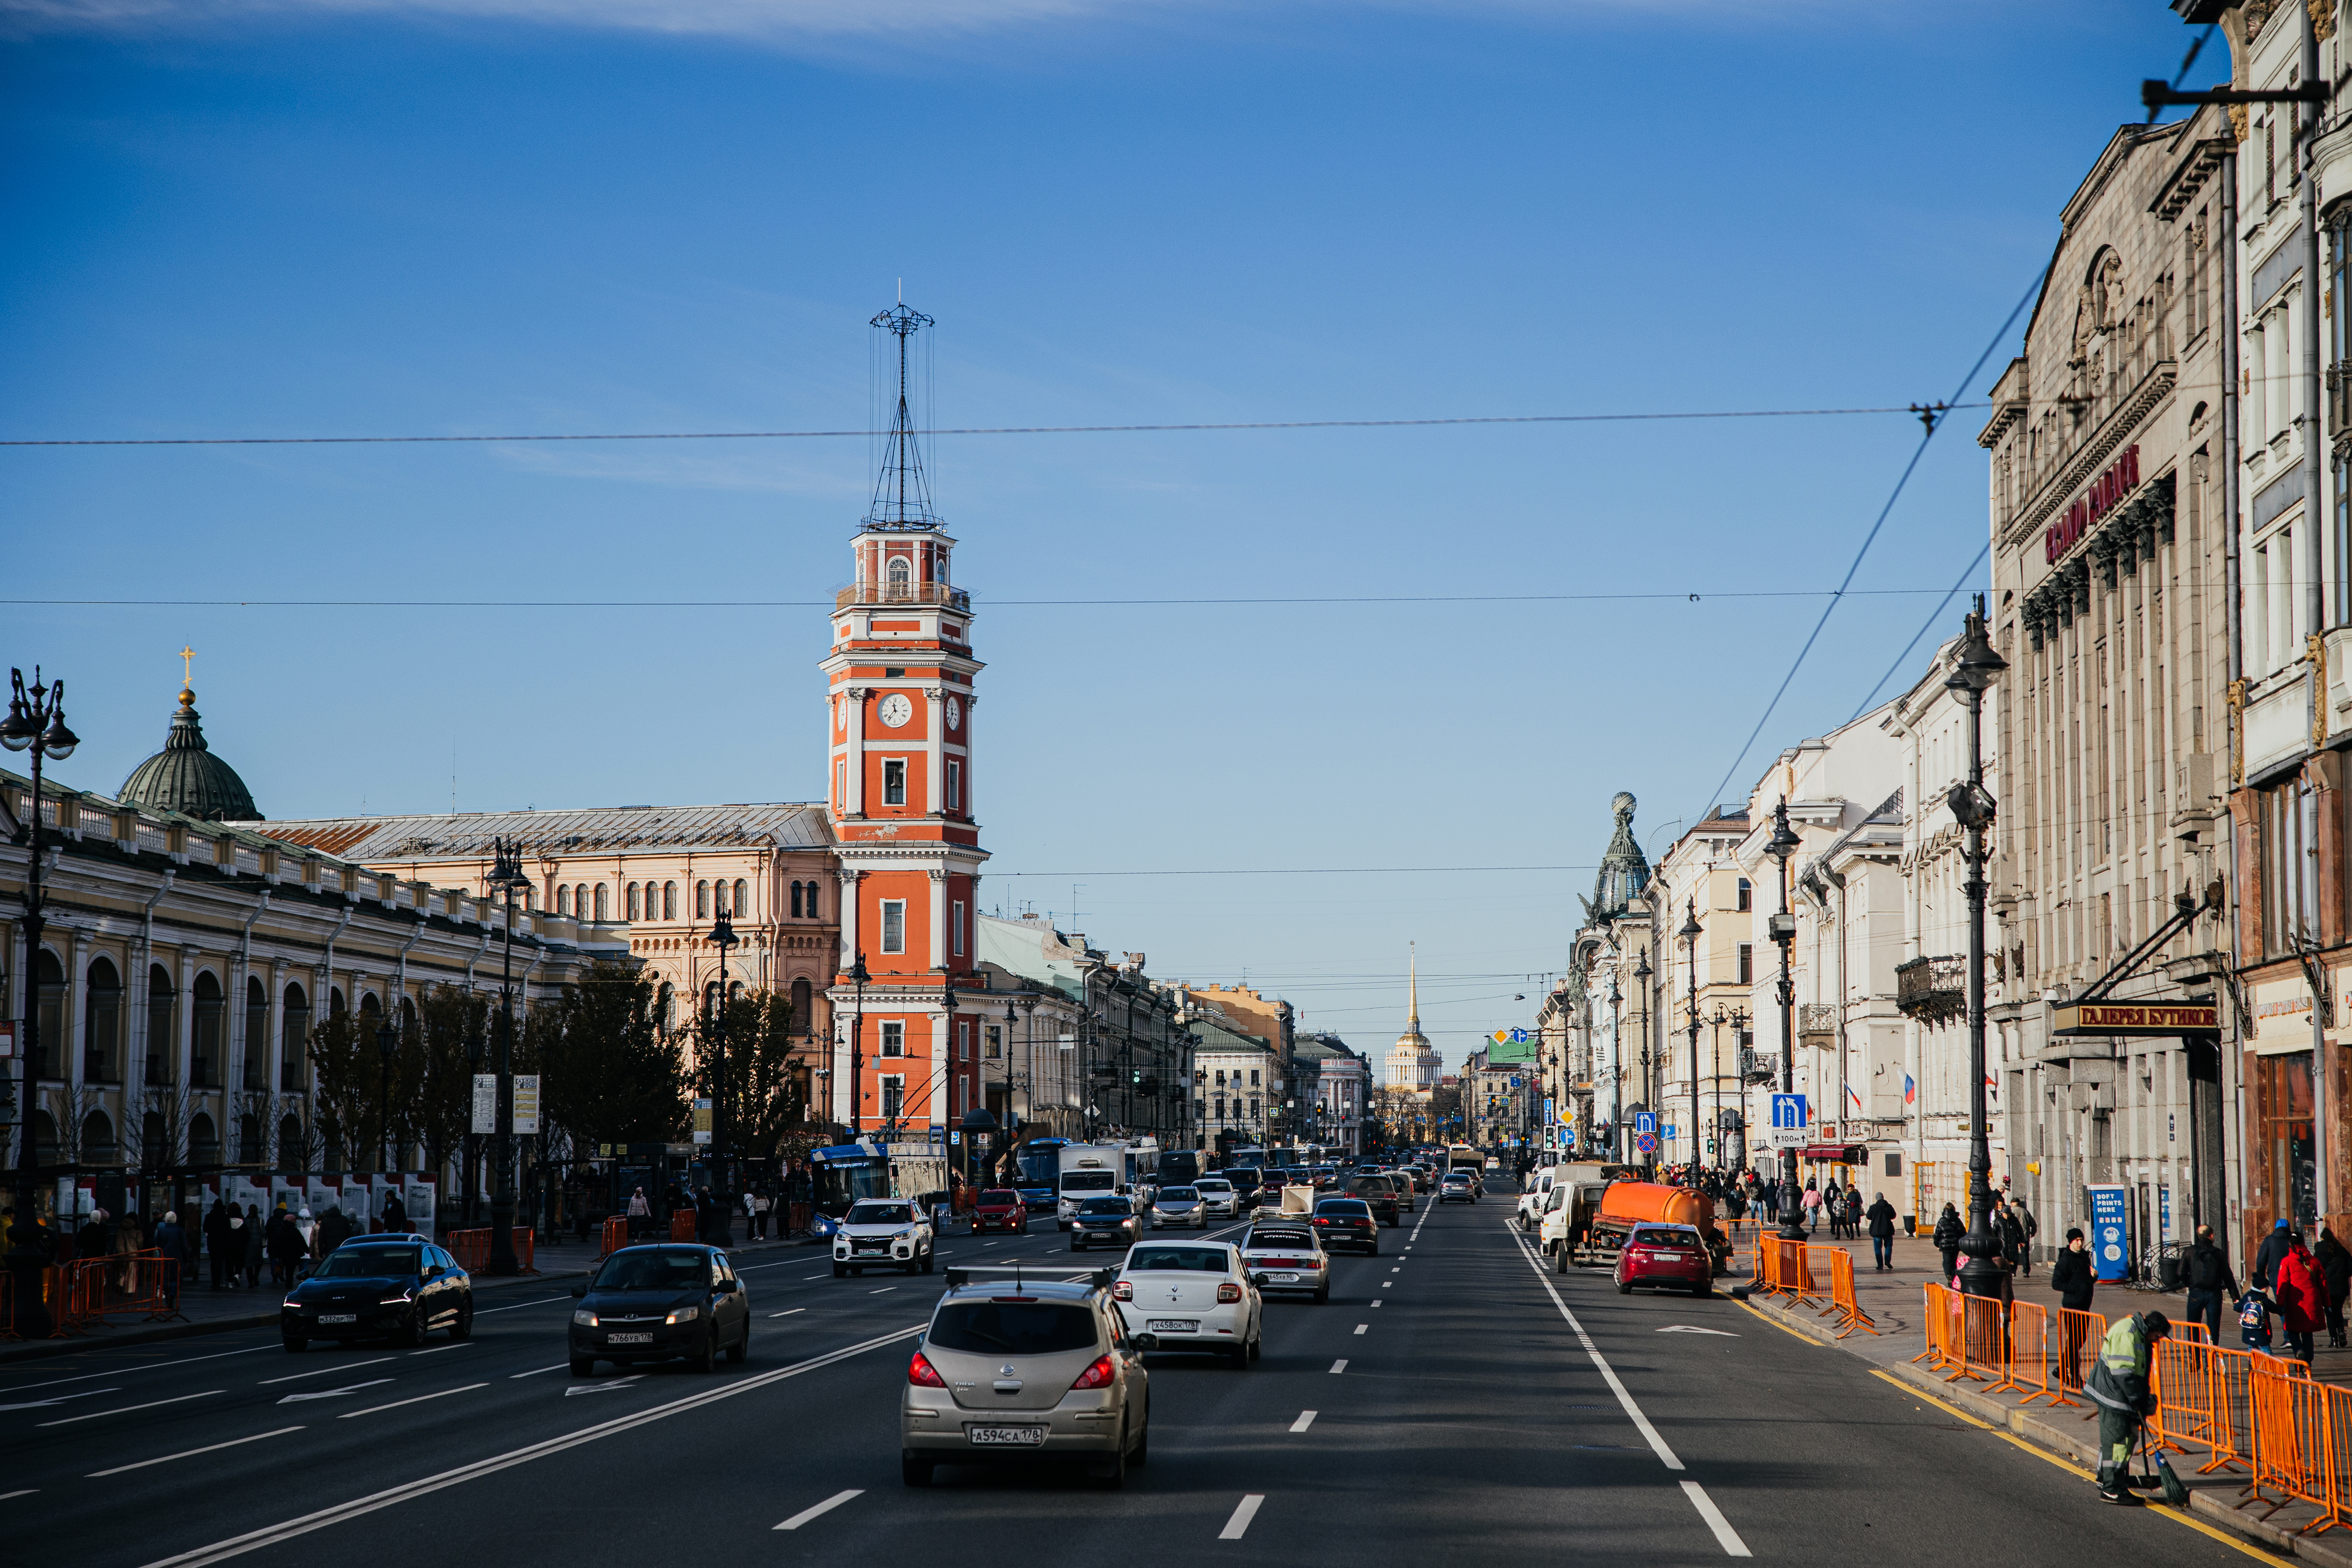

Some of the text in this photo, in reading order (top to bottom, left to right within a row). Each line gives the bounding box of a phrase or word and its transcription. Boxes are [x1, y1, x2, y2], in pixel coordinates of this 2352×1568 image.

[2081, 1008, 2215, 1026] ГАЛЕРЕЯ БУТИКОВ
[976, 1430, 1038, 1442] А594СА 178
